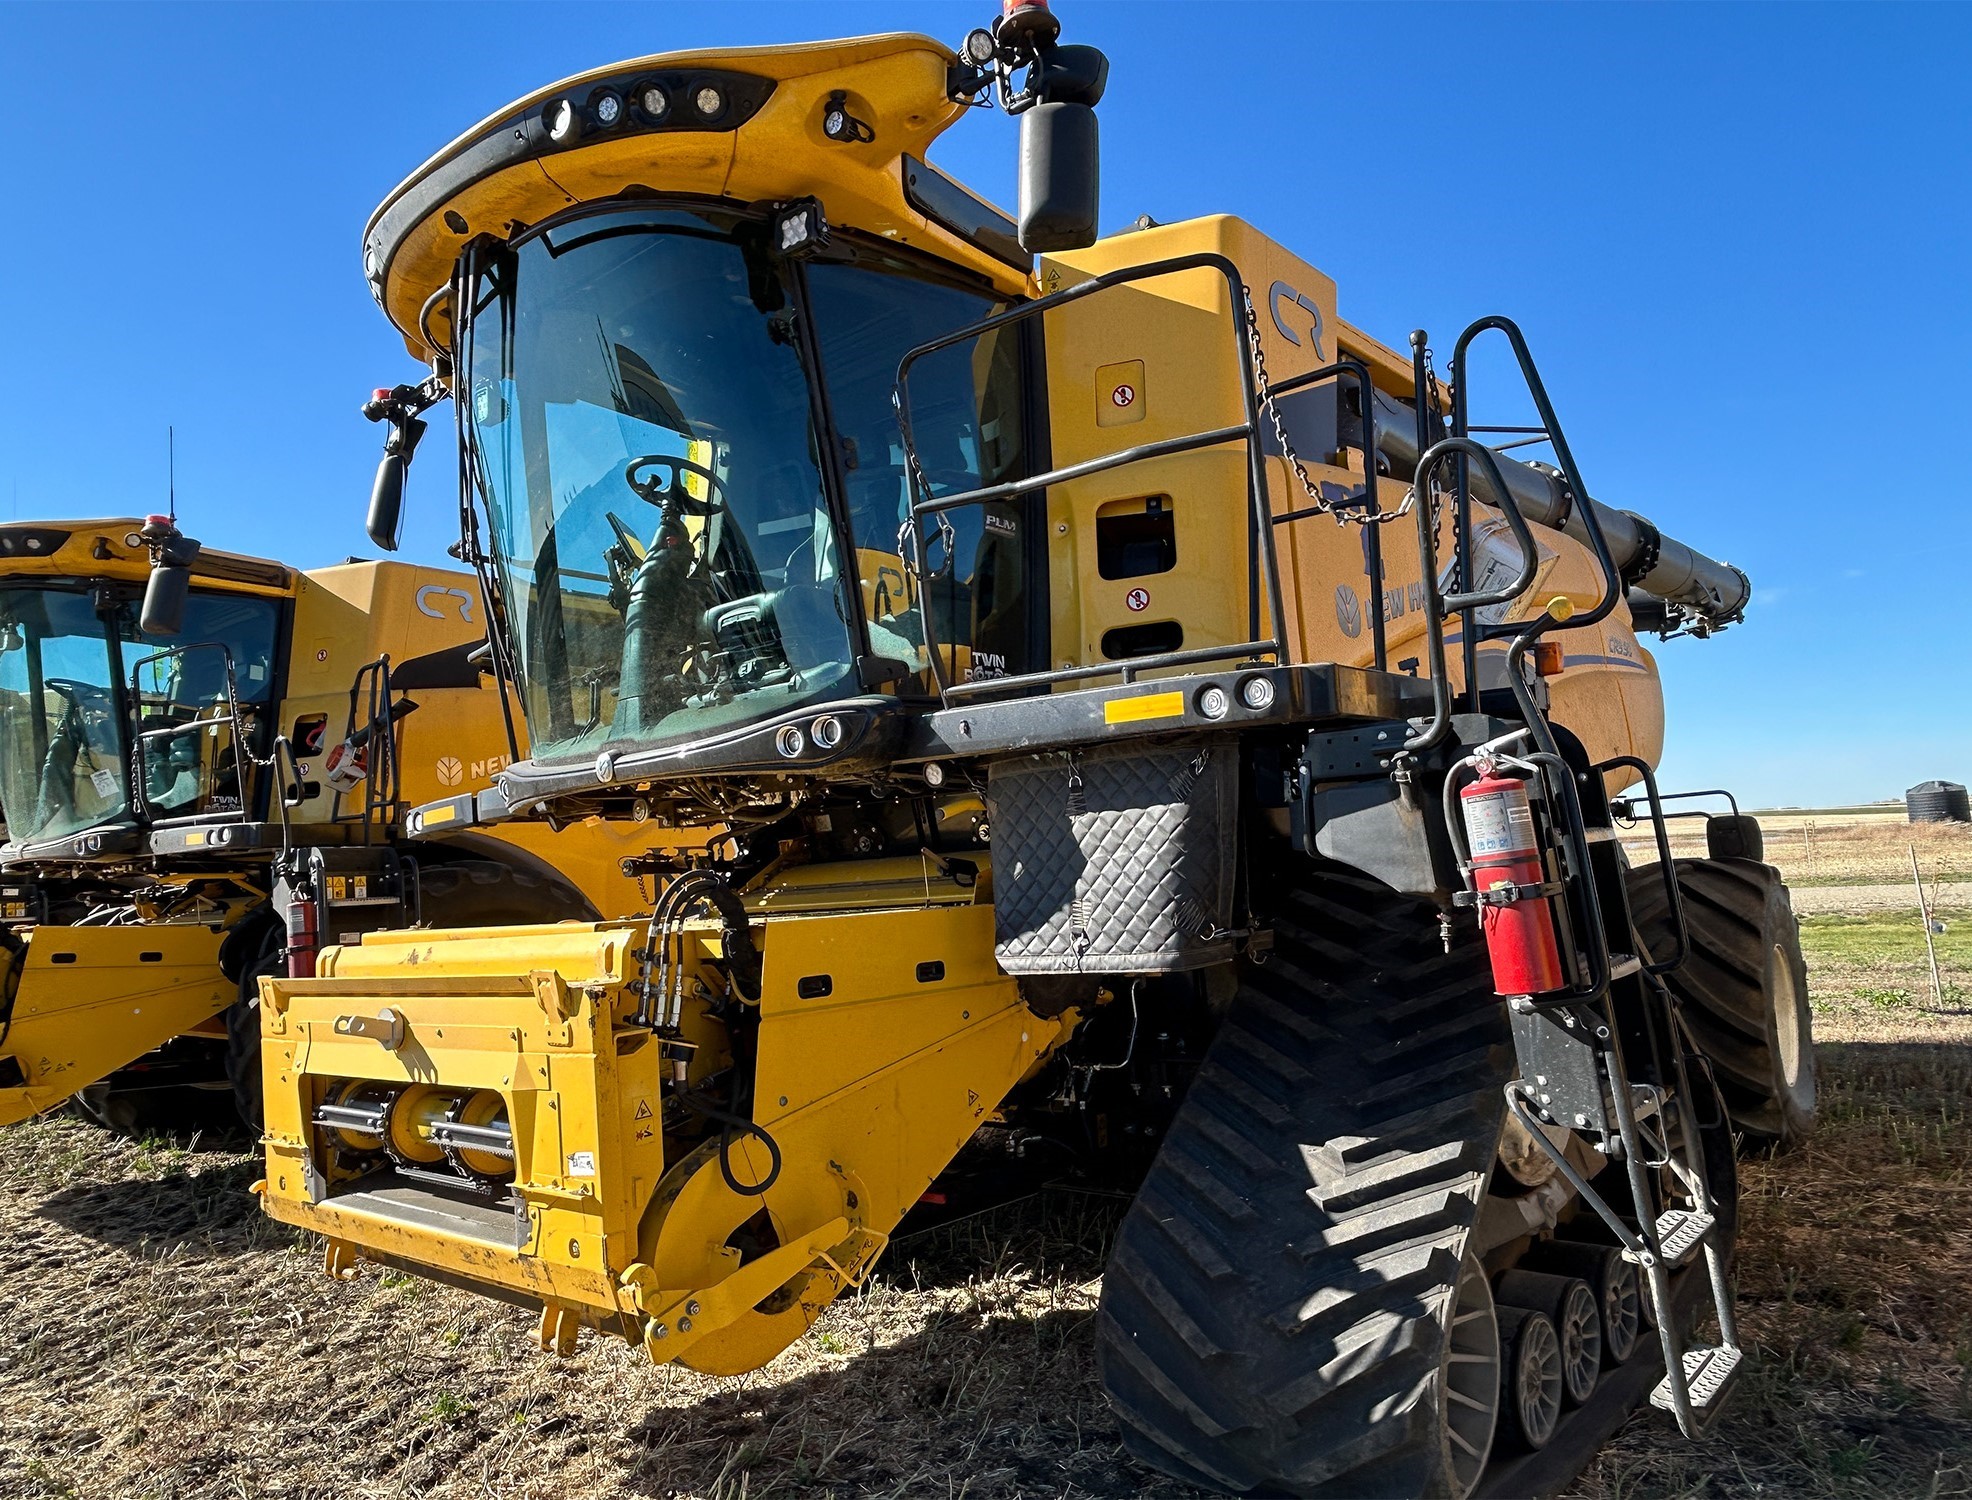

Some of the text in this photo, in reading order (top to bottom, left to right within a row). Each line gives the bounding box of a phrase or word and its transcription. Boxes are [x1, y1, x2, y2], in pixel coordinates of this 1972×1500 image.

[1269, 280, 1325, 362] CR
[986, 514, 1016, 531] PLM
[416, 585, 473, 623] CR
[972, 651, 1005, 669] TWIN
[964, 665, 1012, 682] ROTO
[212, 795, 238, 804] TWIN
